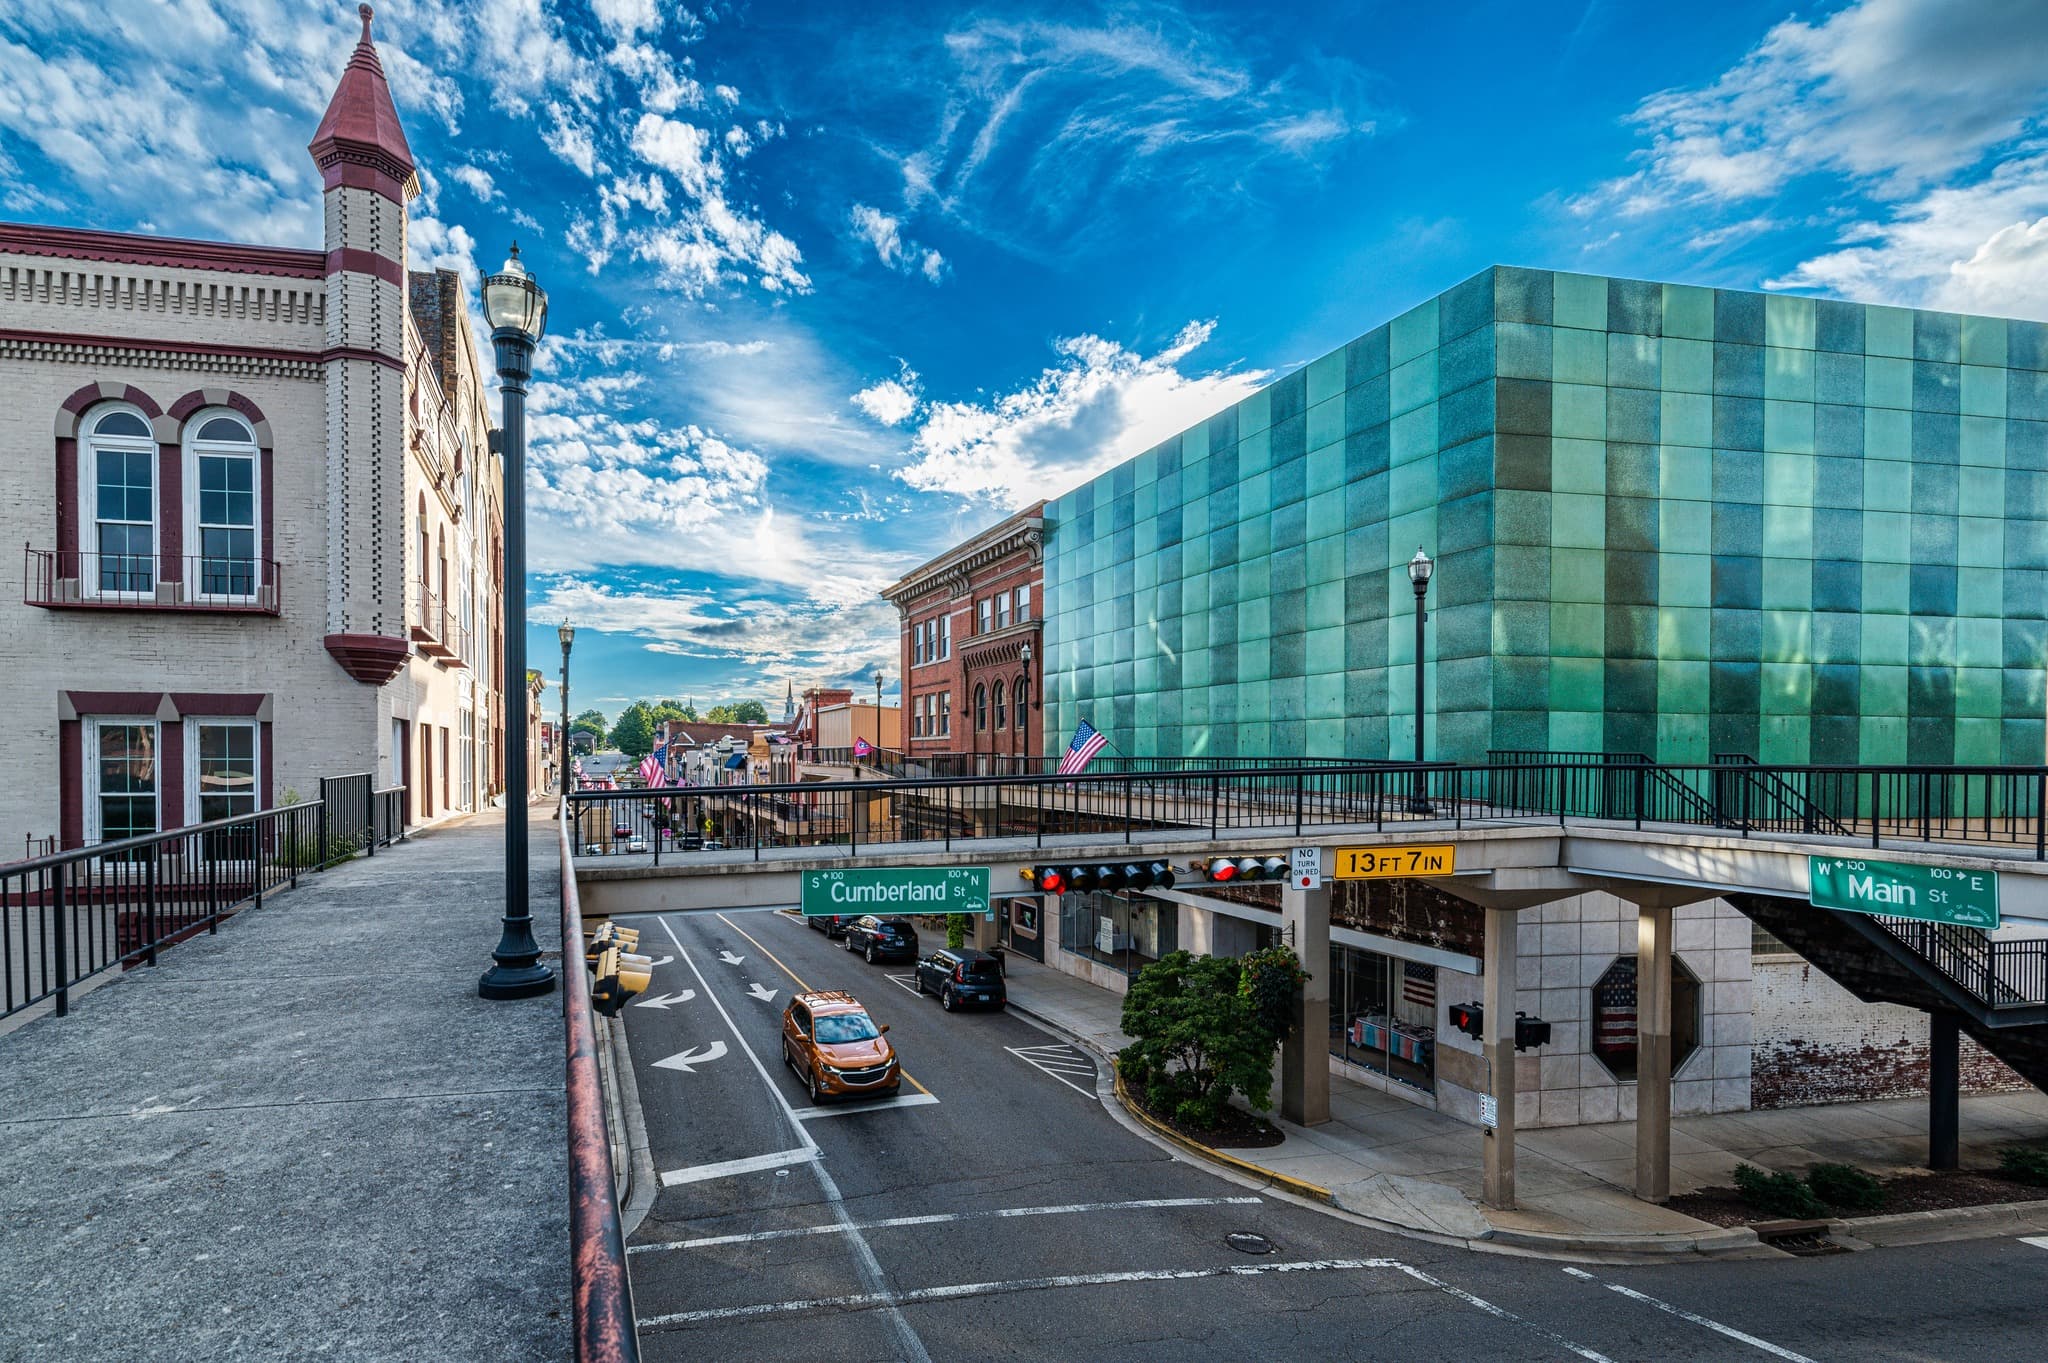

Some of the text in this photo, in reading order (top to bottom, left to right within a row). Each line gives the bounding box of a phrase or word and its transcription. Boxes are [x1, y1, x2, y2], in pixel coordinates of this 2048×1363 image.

[1300, 849, 1314, 858] NO
[1350, 851, 1442, 873] 13 FT 7 IN
[1847, 861, 1866, 871] 100
[948, 870, 961, 878] 100
[1817, 862, 1831, 875] W
[1930, 868, 1951, 880] 100
[830, 872, 844, 880] 100
[970, 875, 979, 886] N
[812, 877, 820, 888] S
[1971, 877, 1984, 891] E
[831, 880, 946, 903] Cumberland
[953, 886, 966, 897] St
[1849, 874, 1949, 906] Main St
